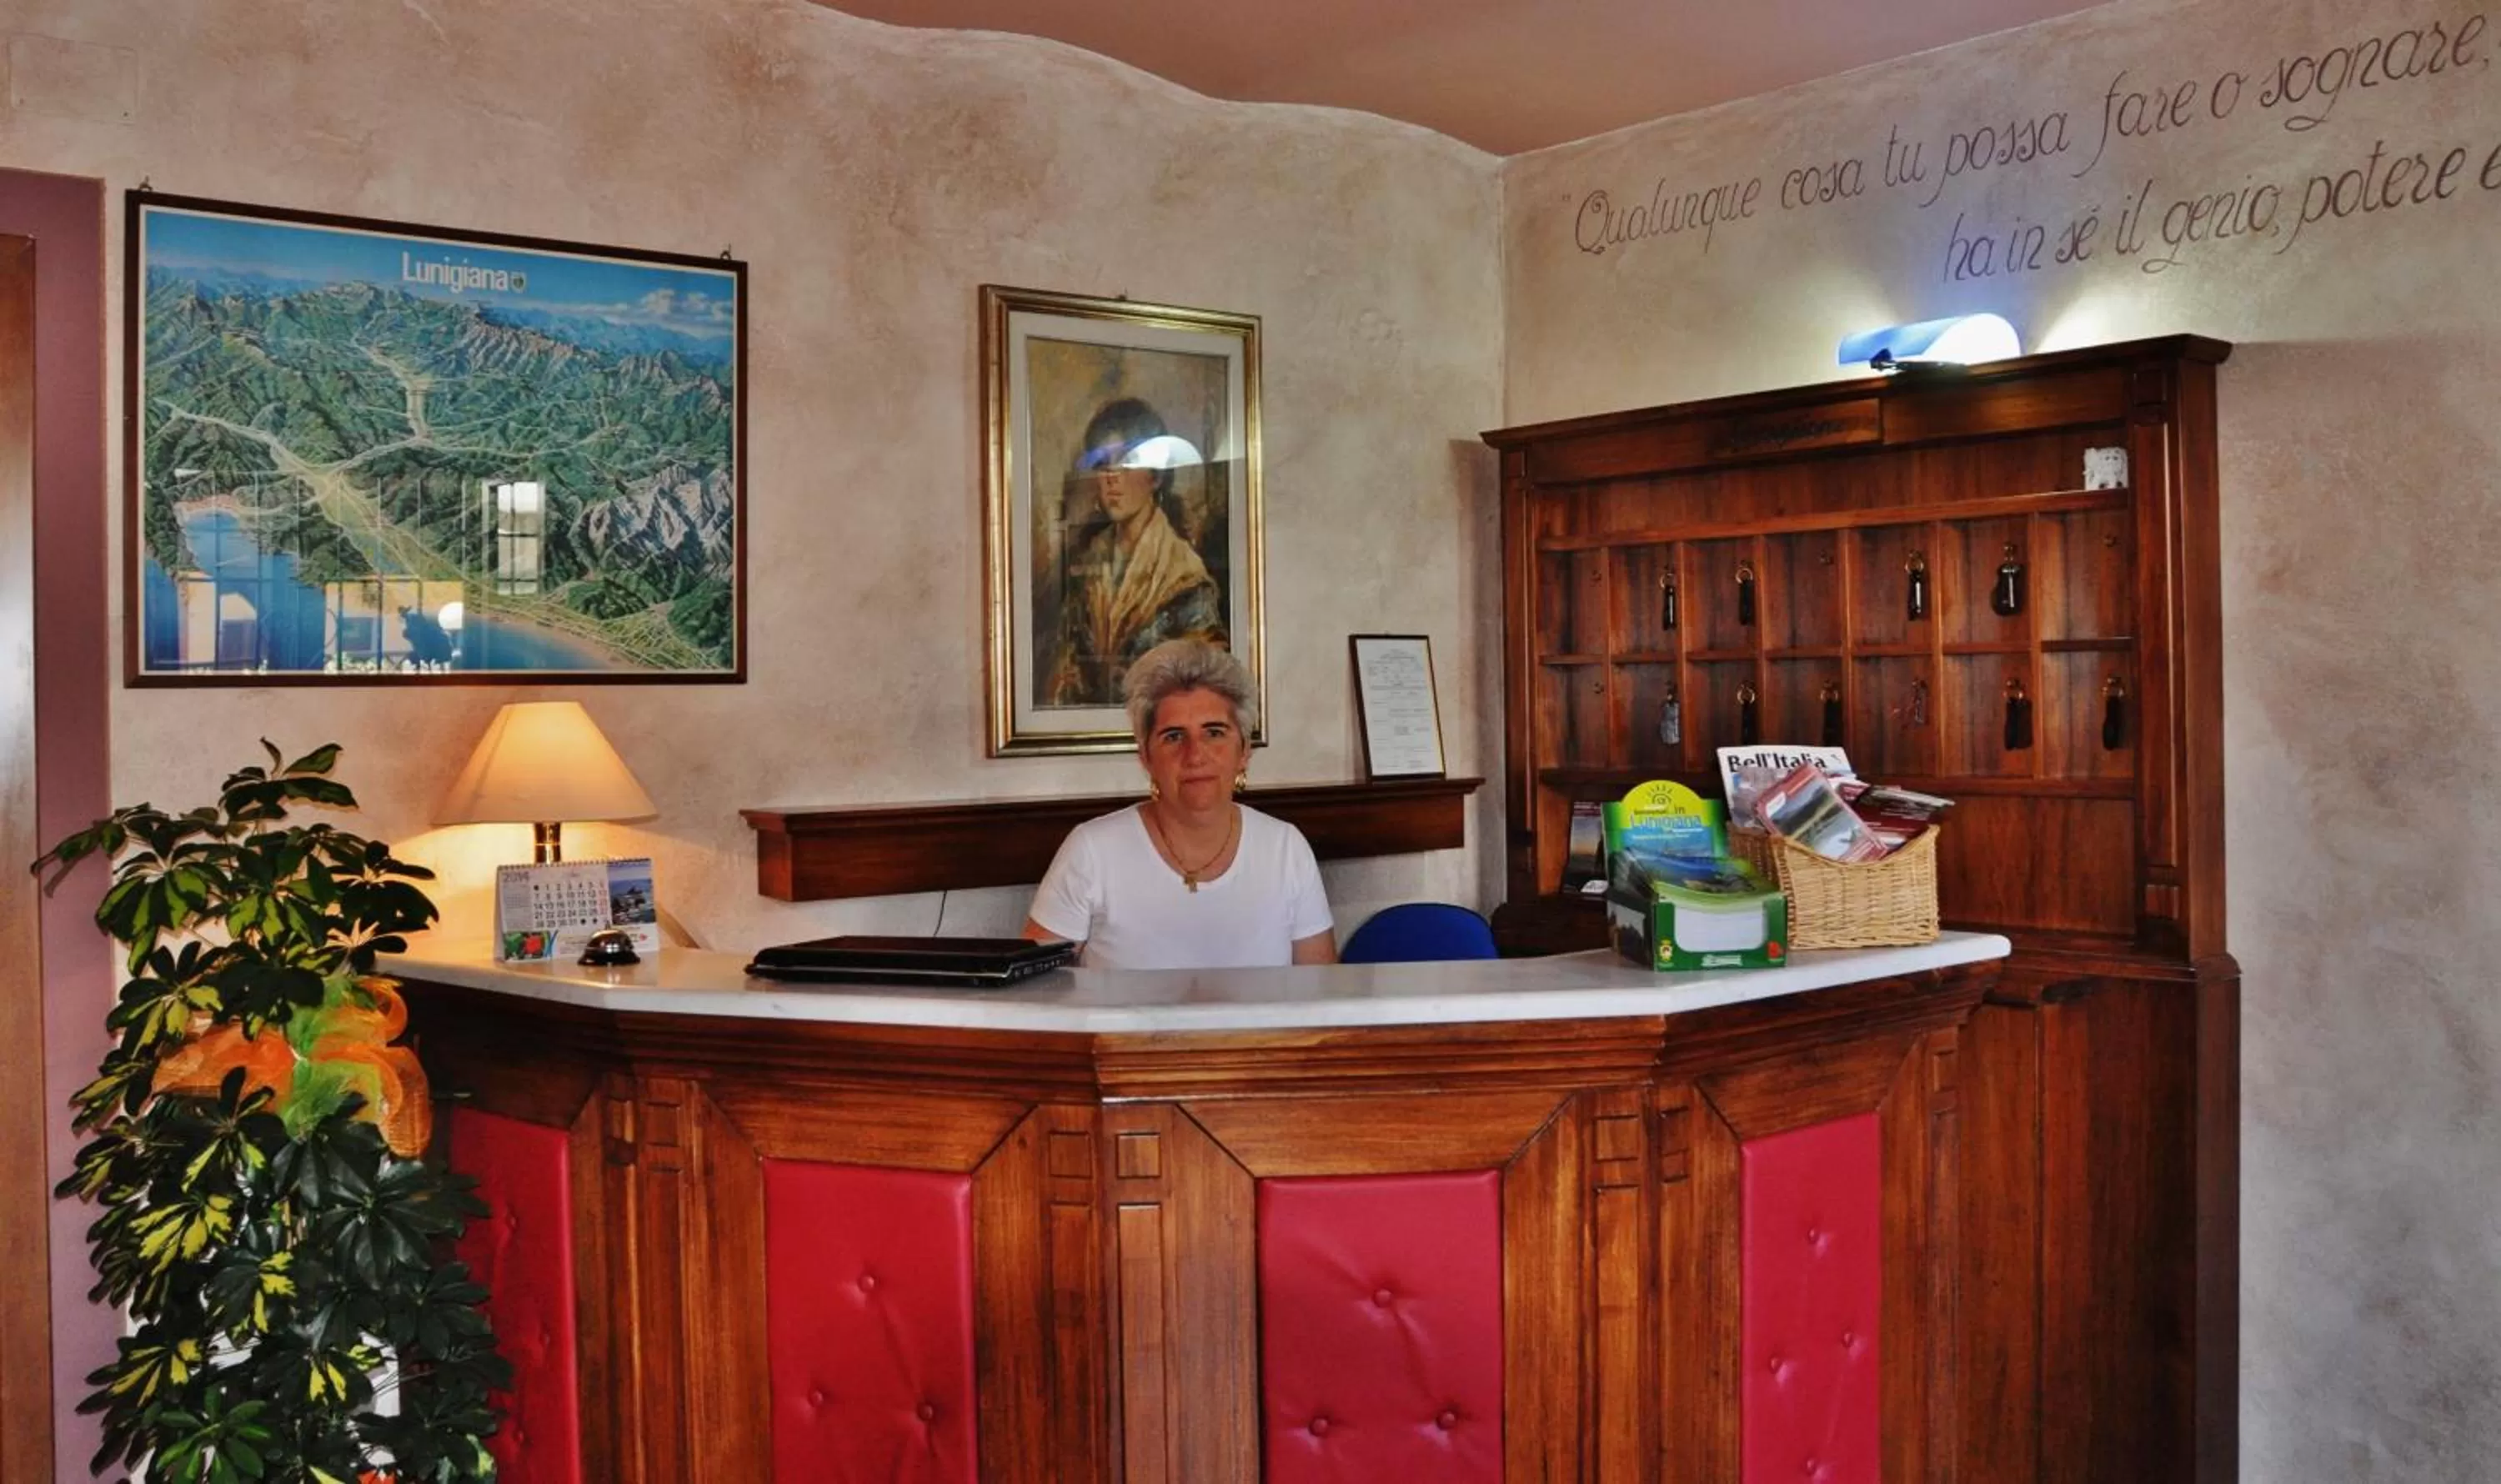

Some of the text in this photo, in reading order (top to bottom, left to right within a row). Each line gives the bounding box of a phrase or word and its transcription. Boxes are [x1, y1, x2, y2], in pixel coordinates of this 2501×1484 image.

[1782, 158, 1867, 210] cosa
[1884, 123, 1927, 188] tu
[1918, 111, 2070, 209] possa
[2071, 69, 2198, 178] fare
[2210, 71, 2249, 119] o
[2260, 14, 2489, 132] sognare,
[402, 251, 509, 294] Lunigiana
[2115, 178, 2154, 256] il
[2142, 174, 2285, 274] genio,
[2273, 139, 2467, 256] potere
